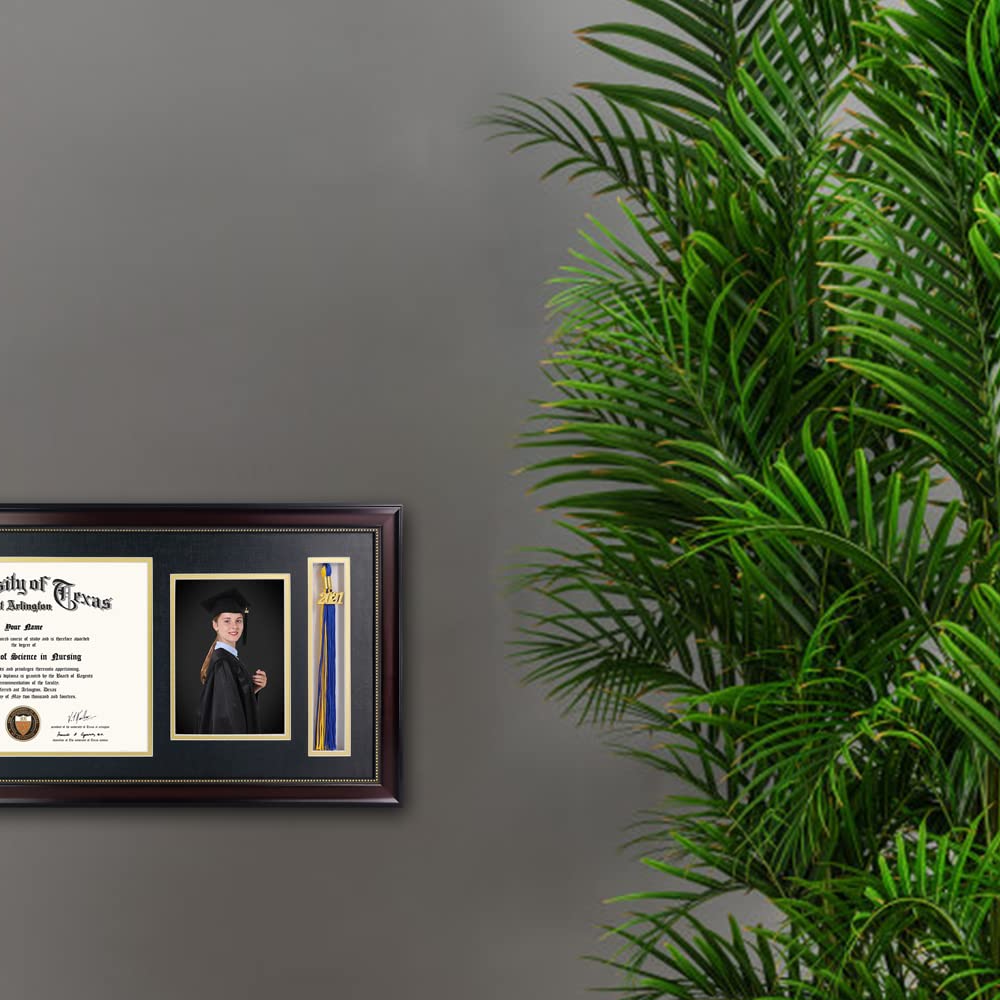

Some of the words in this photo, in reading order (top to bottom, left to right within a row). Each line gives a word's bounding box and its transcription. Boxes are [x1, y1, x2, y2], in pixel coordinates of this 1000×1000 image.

[29, 576, 51, 592] of
[52, 579, 113, 611] Texas
[6, 600, 53, 613] Arlington
[4, 623, 21, 631] Your
[23, 623, 43, 631] Name
[51, 653, 82, 662] Nursing
